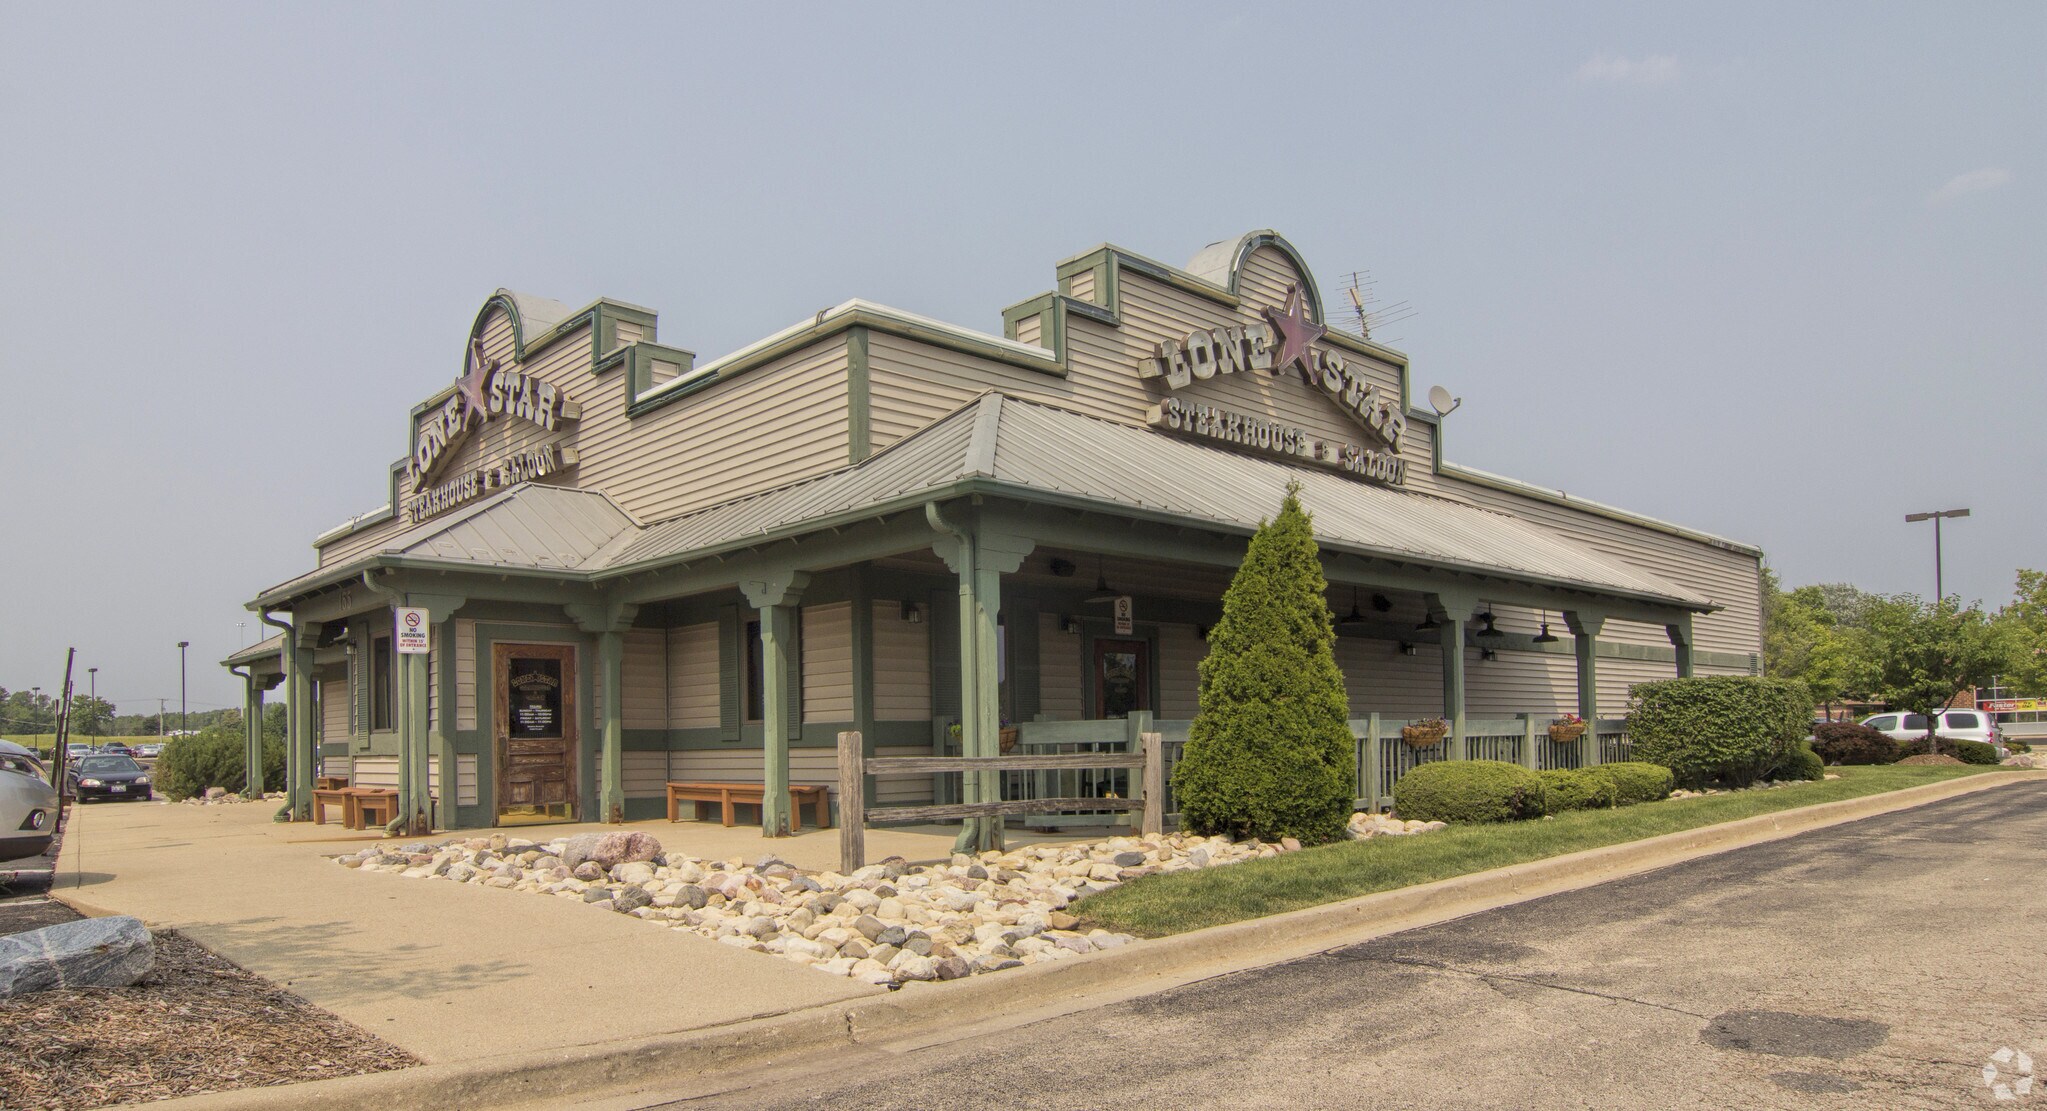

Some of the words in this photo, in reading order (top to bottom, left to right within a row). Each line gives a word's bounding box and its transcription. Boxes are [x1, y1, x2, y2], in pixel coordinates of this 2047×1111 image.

[406, 393, 465, 494] LONE
[489, 371, 559, 432] STAR
[1161, 322, 1272, 391] LONE
[1319, 349, 1407, 455] STAR
[1164, 396, 1306, 457] STEAKHOUSE
[1342, 443, 1408, 485] SALOON
[406, 470, 480, 524] STEAKHOUSE
[502, 443, 557, 485] SALOON
